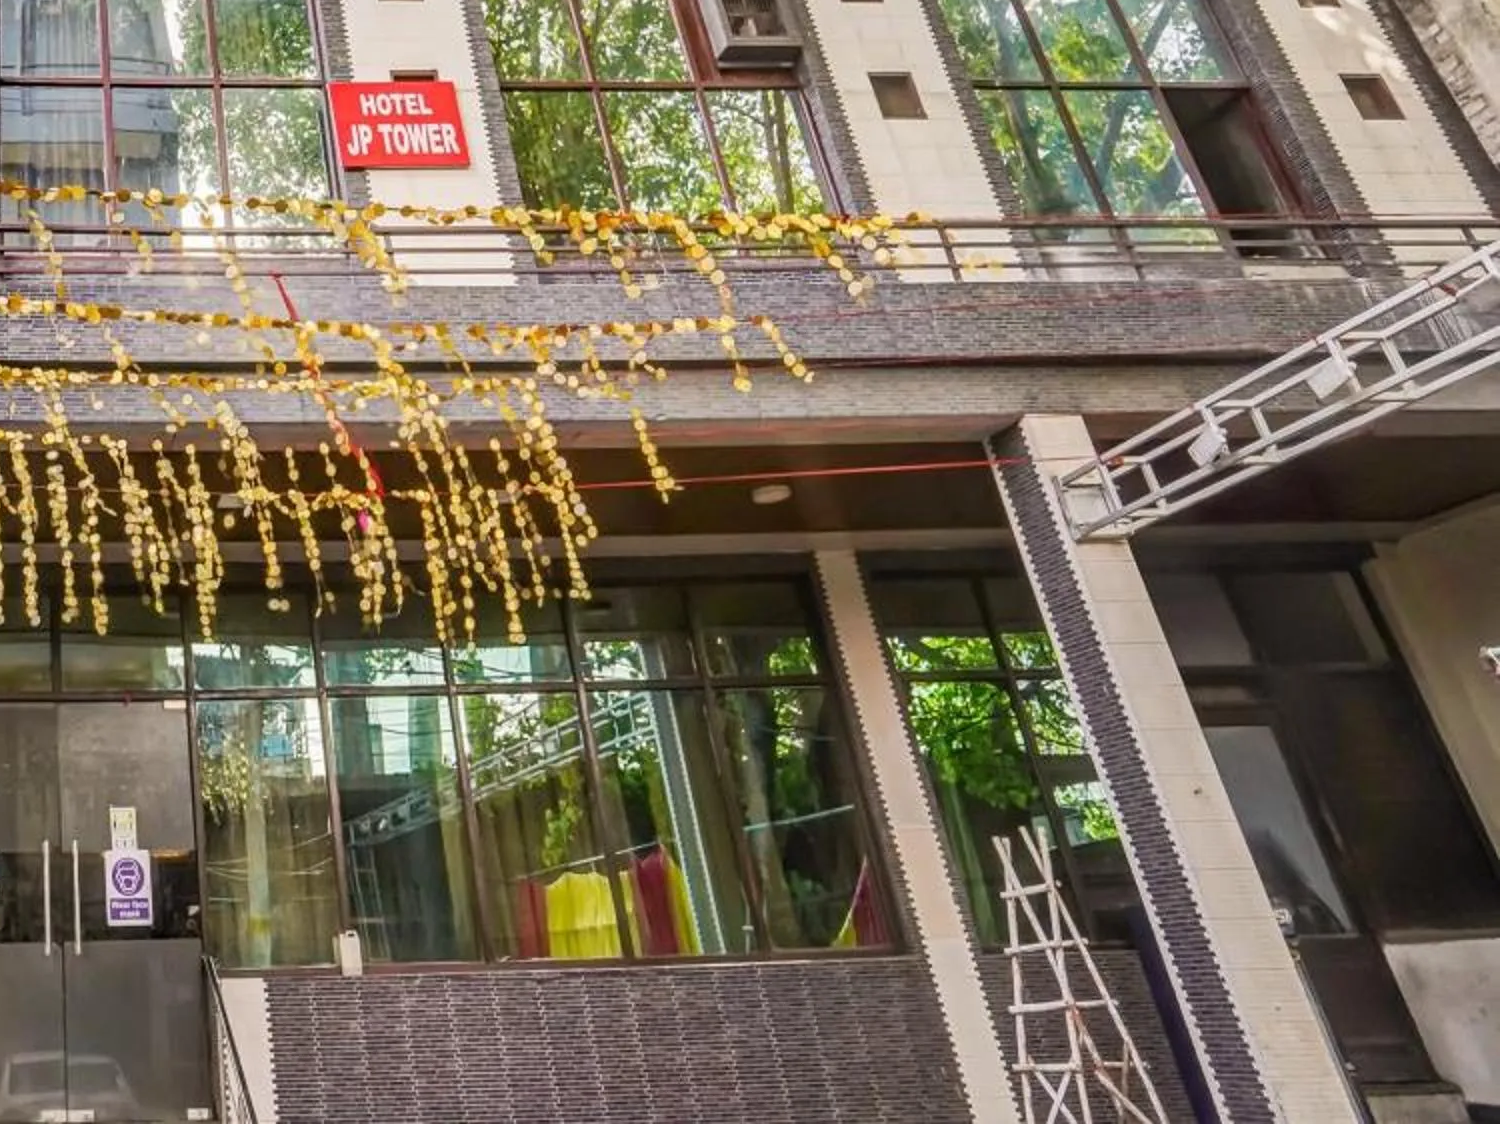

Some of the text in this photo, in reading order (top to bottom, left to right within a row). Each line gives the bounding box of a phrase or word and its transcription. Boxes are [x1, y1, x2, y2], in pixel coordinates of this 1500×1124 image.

[359, 93, 433, 116] HOTEL
[347, 123, 461, 156] JP TOWER
